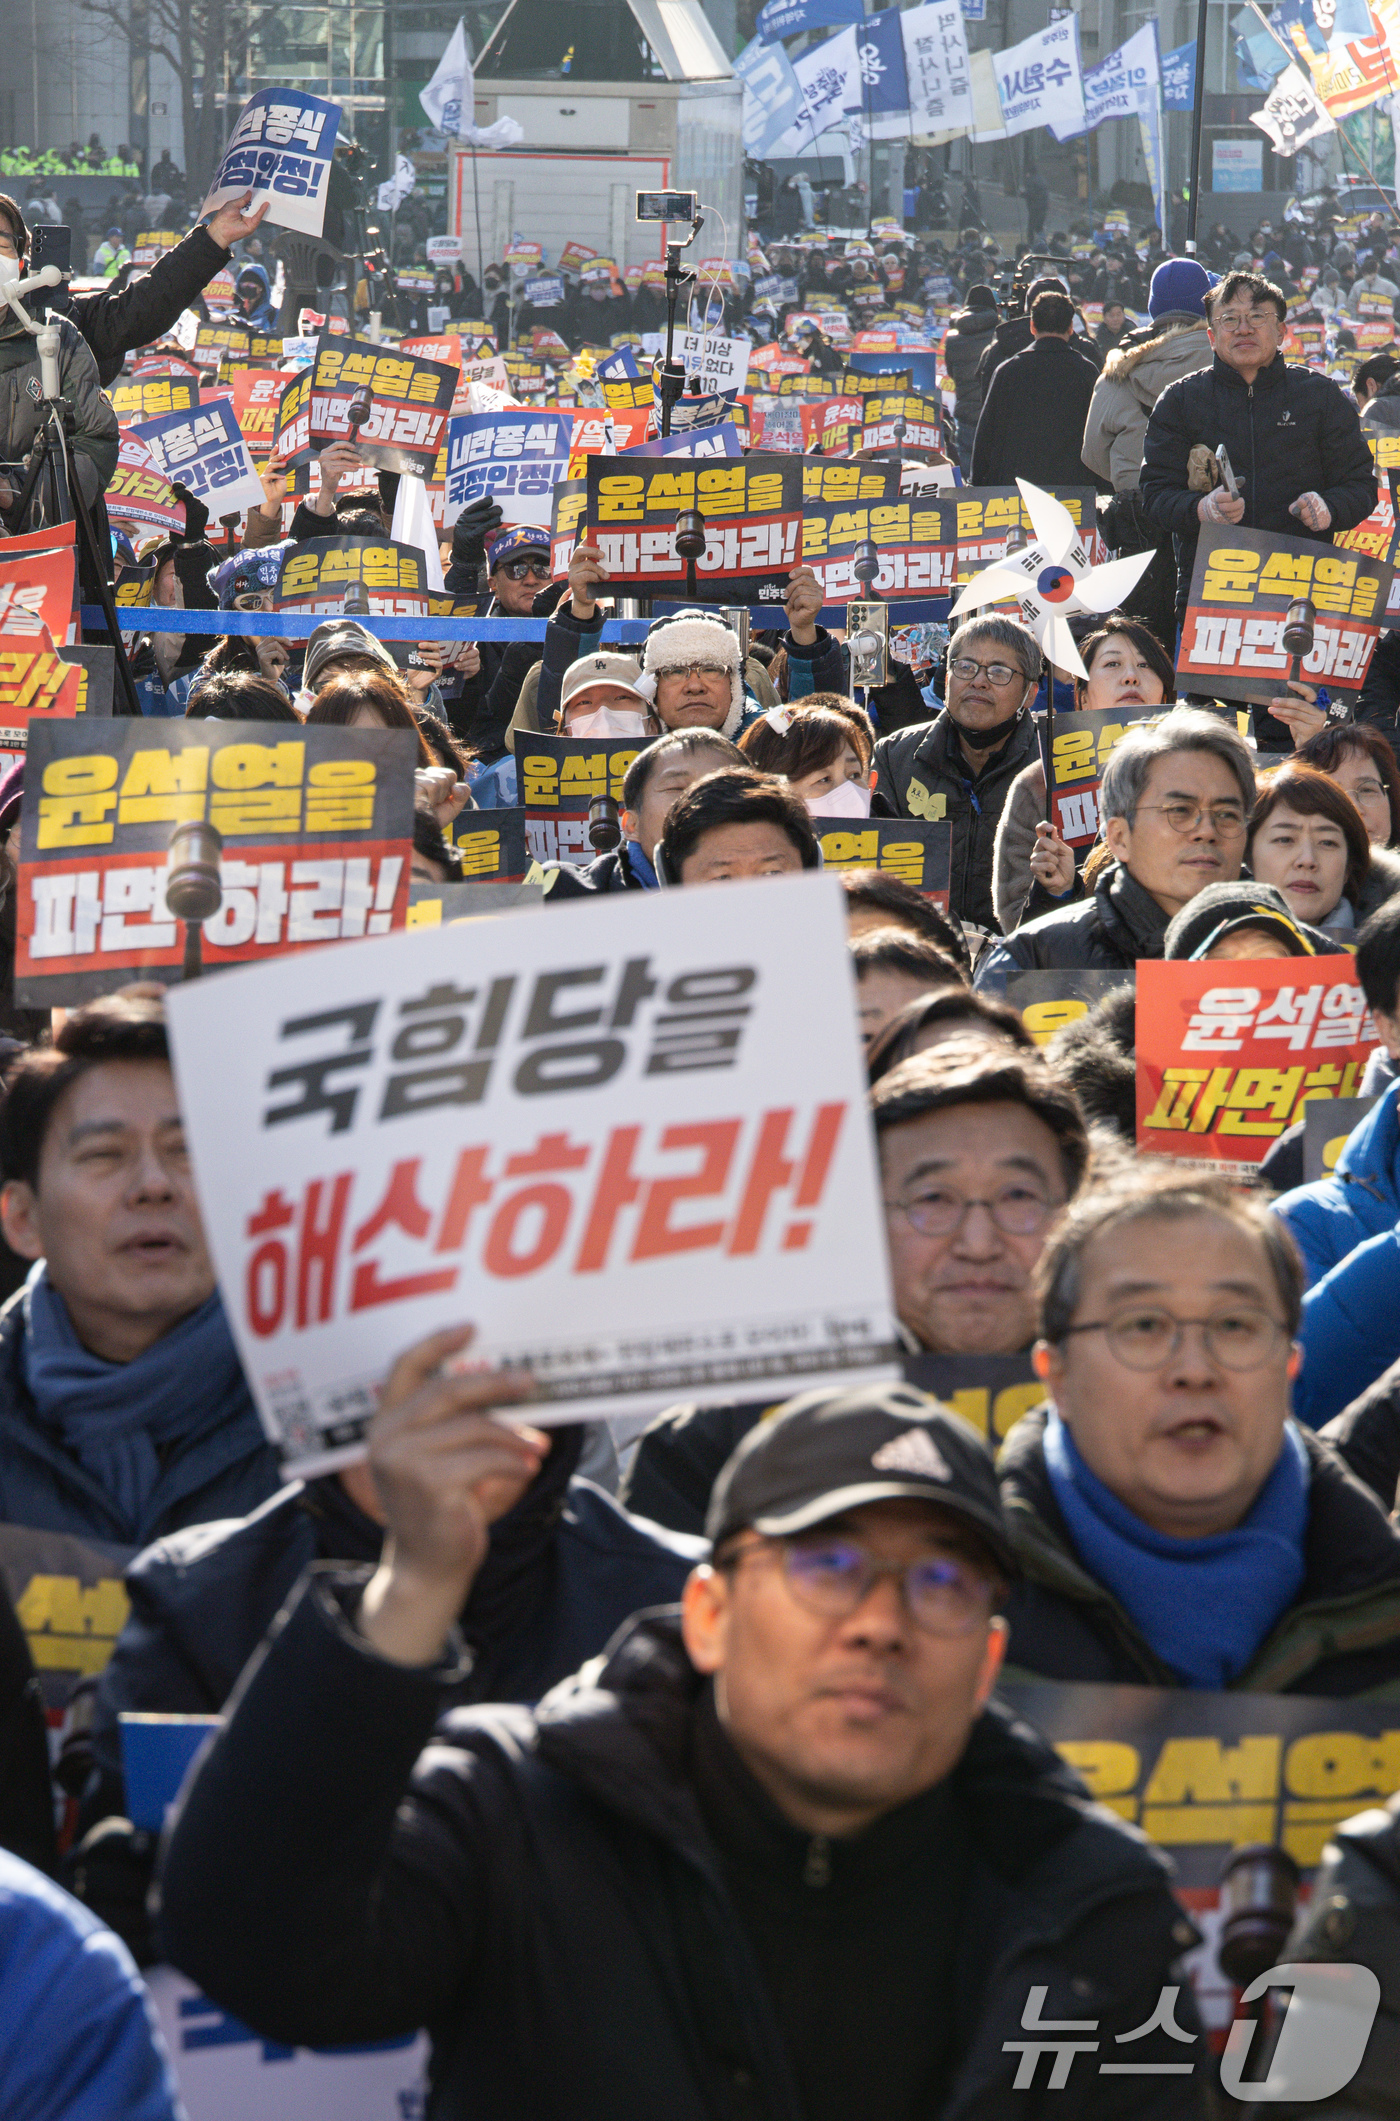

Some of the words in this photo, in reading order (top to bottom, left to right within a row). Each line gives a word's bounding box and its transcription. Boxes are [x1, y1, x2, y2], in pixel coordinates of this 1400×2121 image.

[105, 382, 191, 413] 석열을
[316, 349, 441, 403] 윤석열을
[310, 397, 448, 446] 파면하라!
[862, 423, 939, 449] 파면하라!
[865, 396, 935, 425] 윤석열을
[452, 423, 559, 470] 내란종식
[598, 466, 783, 521] 윤석열을
[595, 519, 799, 573] 파면하라!
[803, 503, 942, 557] 윤석열을
[233, 549, 281, 568] 민주여성
[259, 566, 278, 575] 민주
[260, 575, 278, 583] 여성
[281, 547, 419, 596] 윤석열을
[813, 552, 955, 598] 면하라!
[1201, 548, 1380, 619] 윤석열을
[1189, 615, 1375, 679] 파면하라!
[36, 741, 377, 850] 윤석열을
[28, 855, 405, 958] 파면하라!
[1181, 983, 1379, 1051] 윤석열
[260, 955, 760, 1138] 국힘당을
[243, 1101, 848, 1340] 해산하라!
